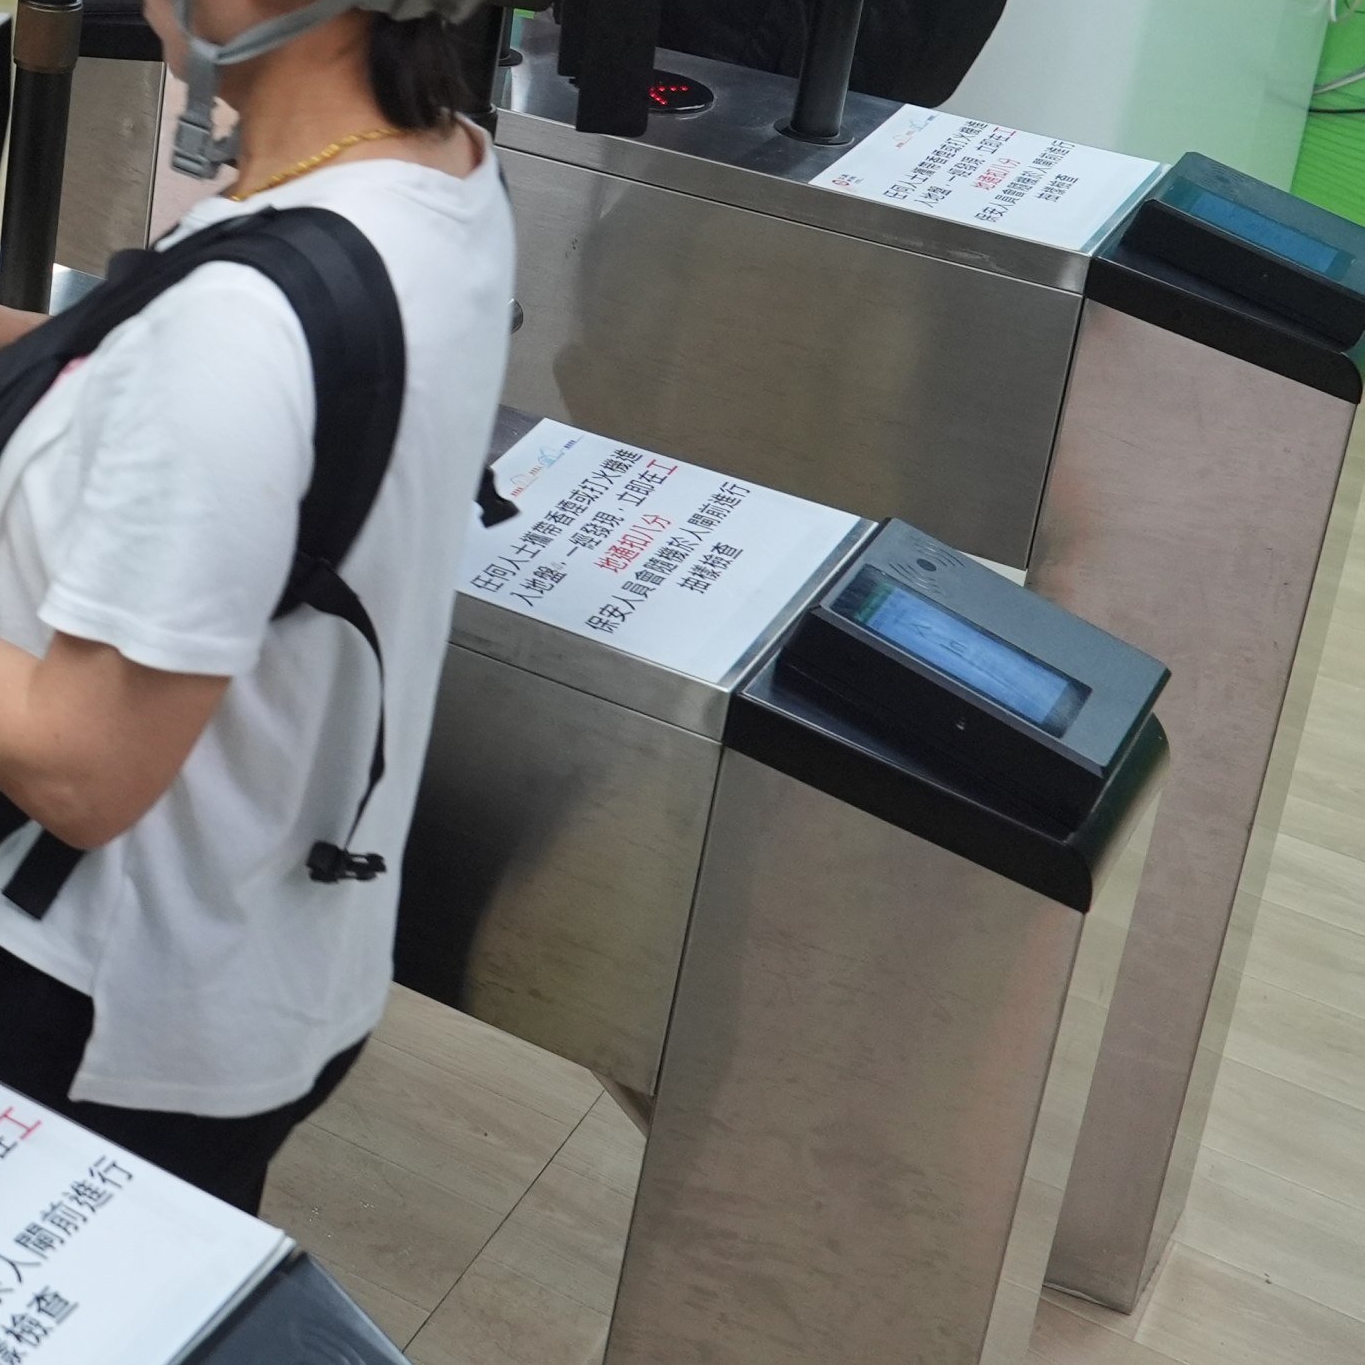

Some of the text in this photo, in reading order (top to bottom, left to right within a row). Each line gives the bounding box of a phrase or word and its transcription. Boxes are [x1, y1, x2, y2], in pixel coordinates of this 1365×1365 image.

[469, 448, 643, 593] 任何人士攜帶香煙或打火機進
[584, 481, 751, 634] 保安人員會隨機於人閘前進行
[593, 513, 672, 575] 地通扣八分
[675, 541, 744, 595] 抽樣檢查
